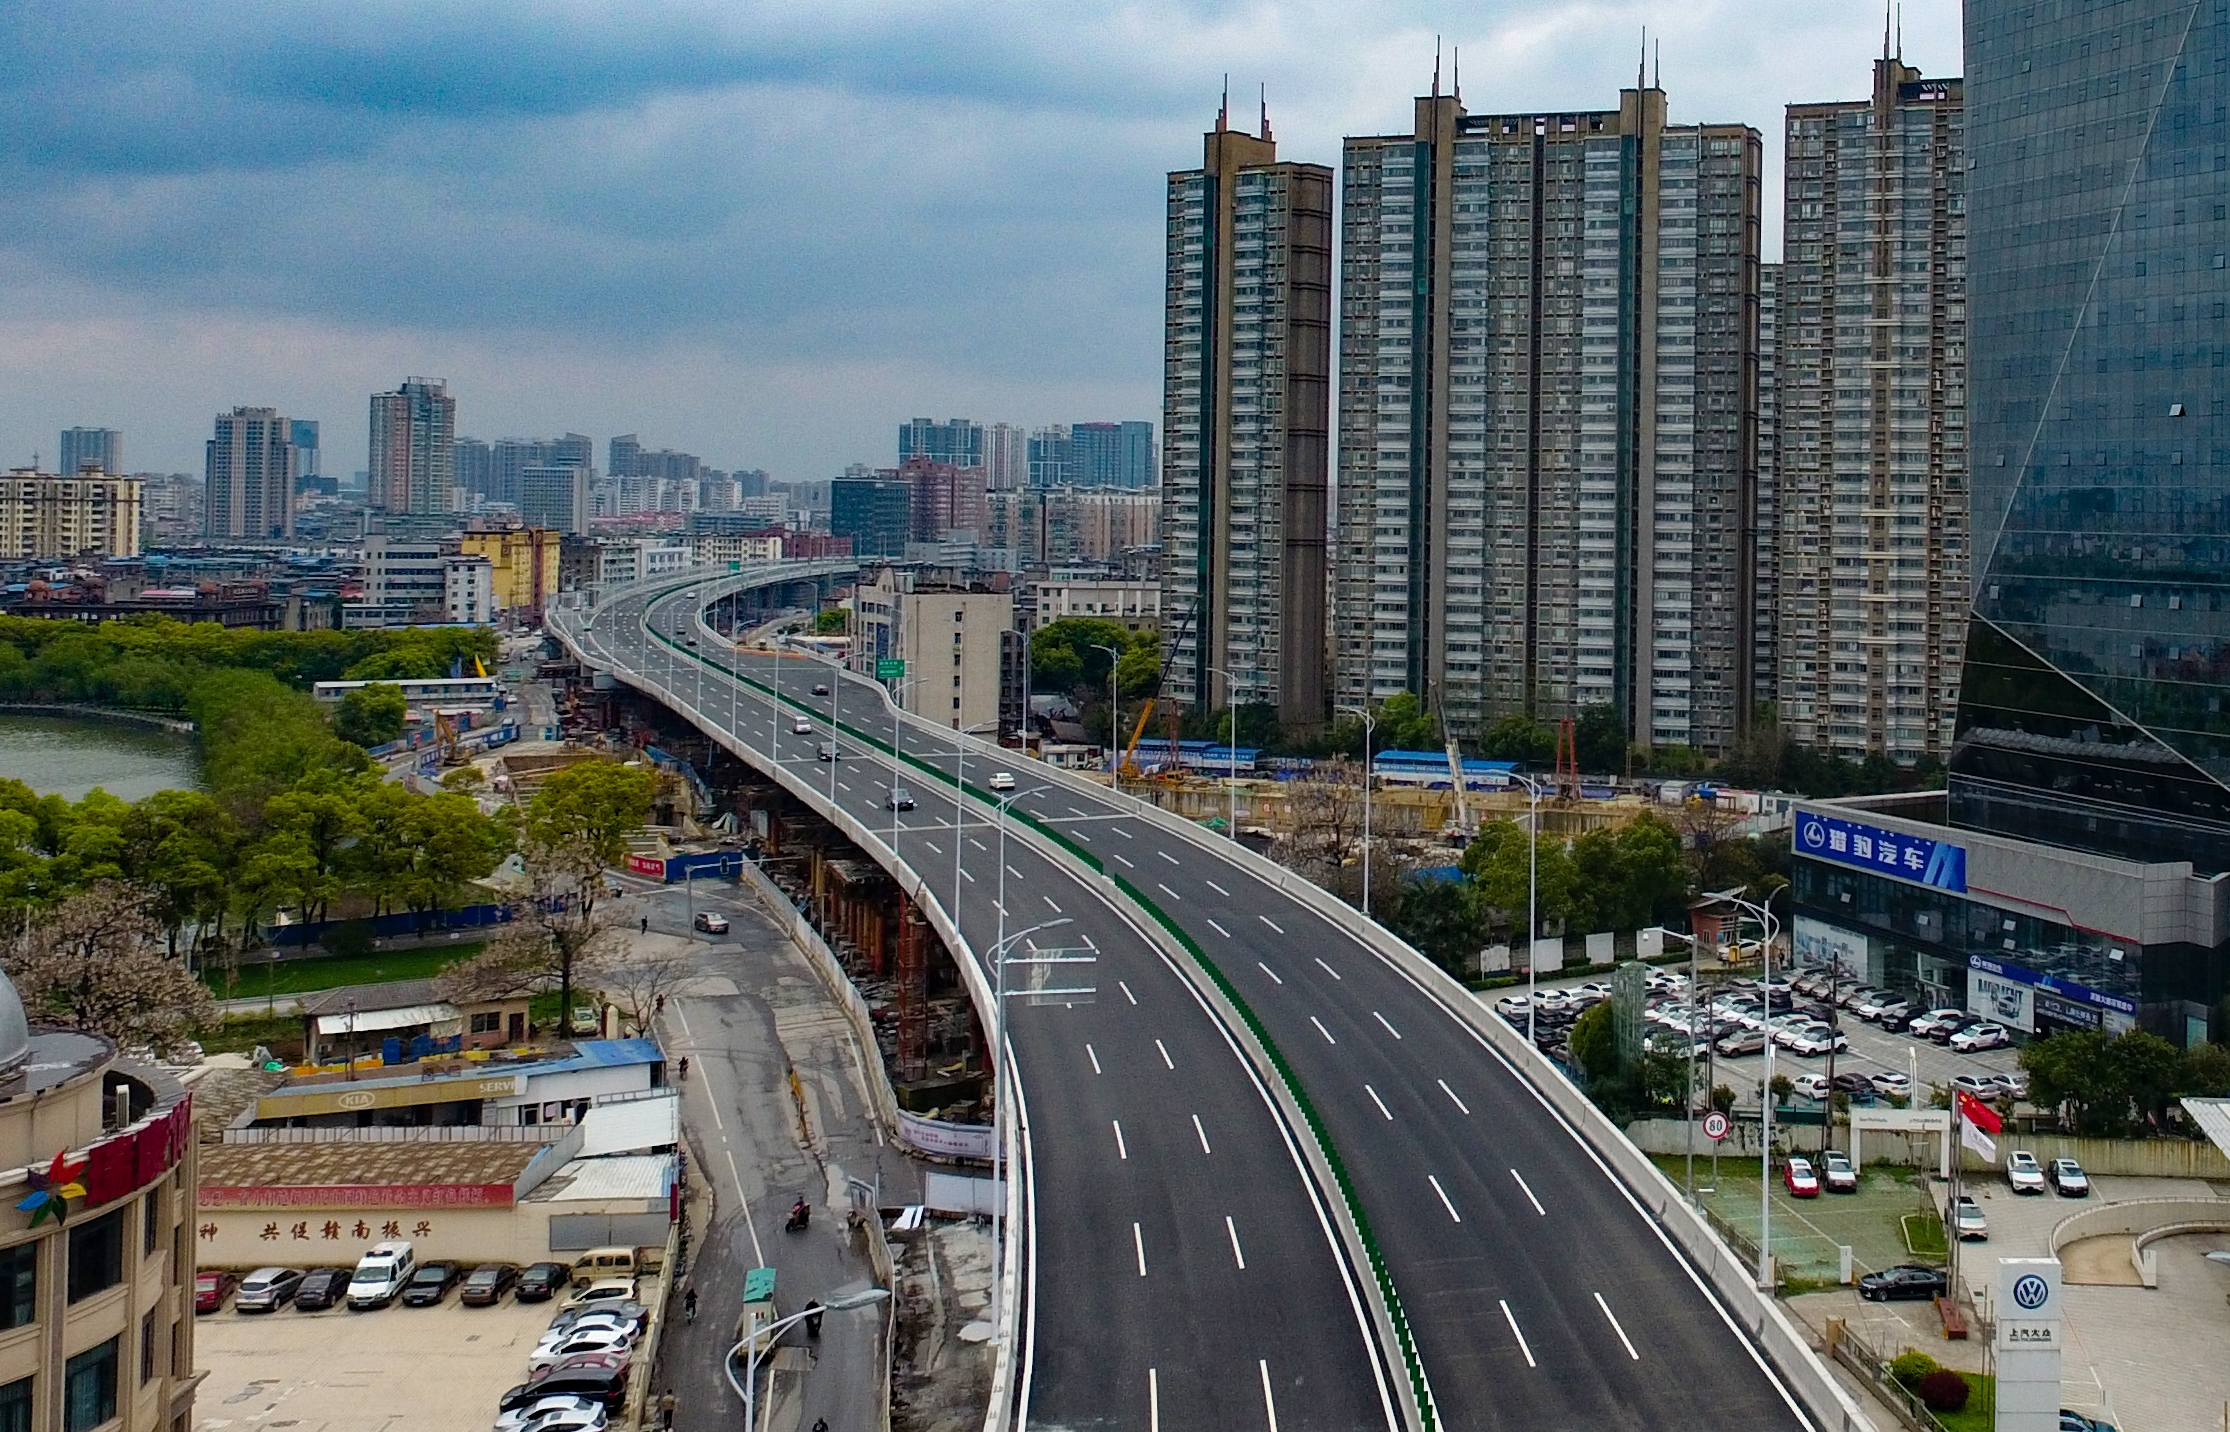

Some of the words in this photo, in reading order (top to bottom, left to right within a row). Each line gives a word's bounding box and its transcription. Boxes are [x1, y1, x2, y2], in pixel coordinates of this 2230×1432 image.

[1828, 828, 1924, 871] 猎豹汽车
[345, 1094, 369, 1107] KIA
[1709, 1119, 1723, 1131] 80
[259, 1218, 432, 1241] 共促赣南振兴
